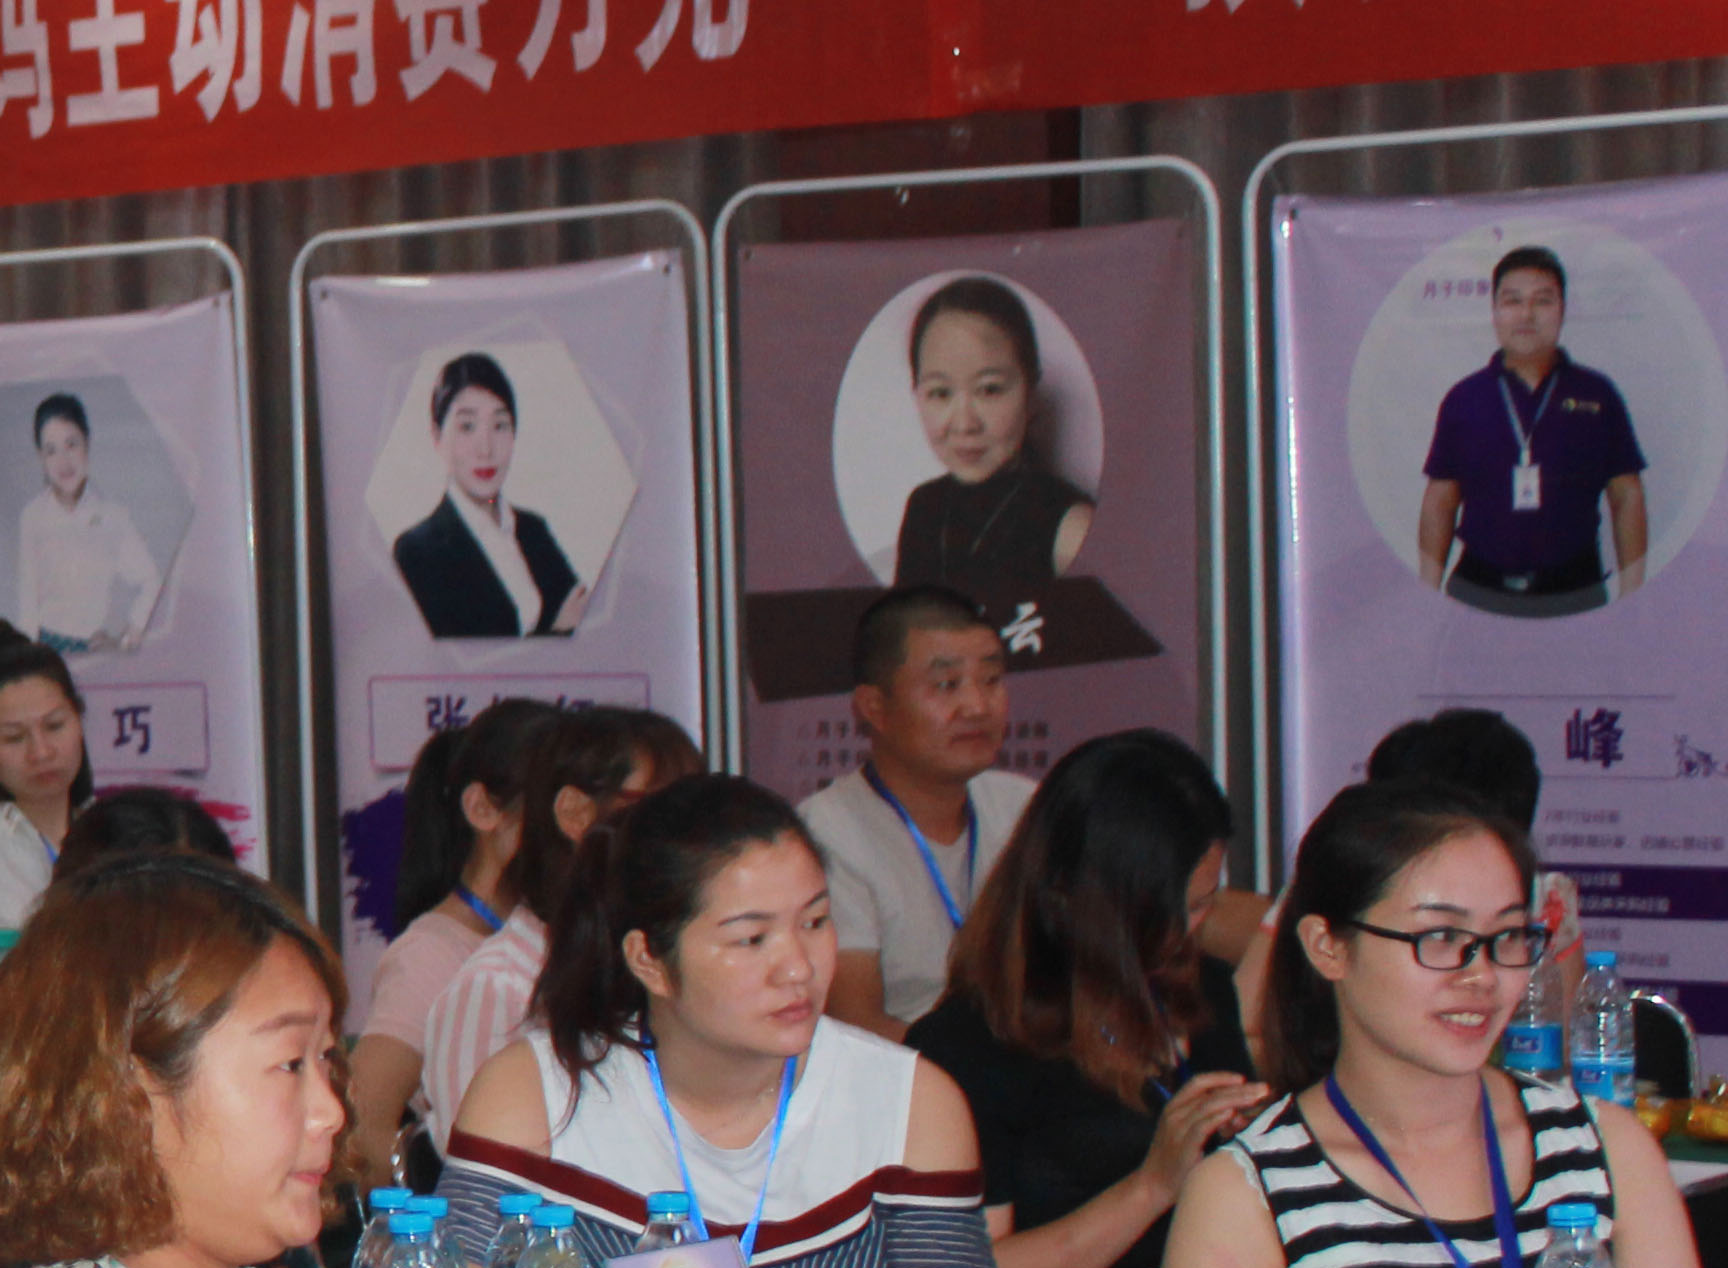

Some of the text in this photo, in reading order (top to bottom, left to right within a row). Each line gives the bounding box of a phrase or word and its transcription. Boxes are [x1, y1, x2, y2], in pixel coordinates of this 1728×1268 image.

[1000, 602, 1044, 654] 云
[113, 705, 153, 754] 巧
[1565, 707, 1625, 769] 峰
